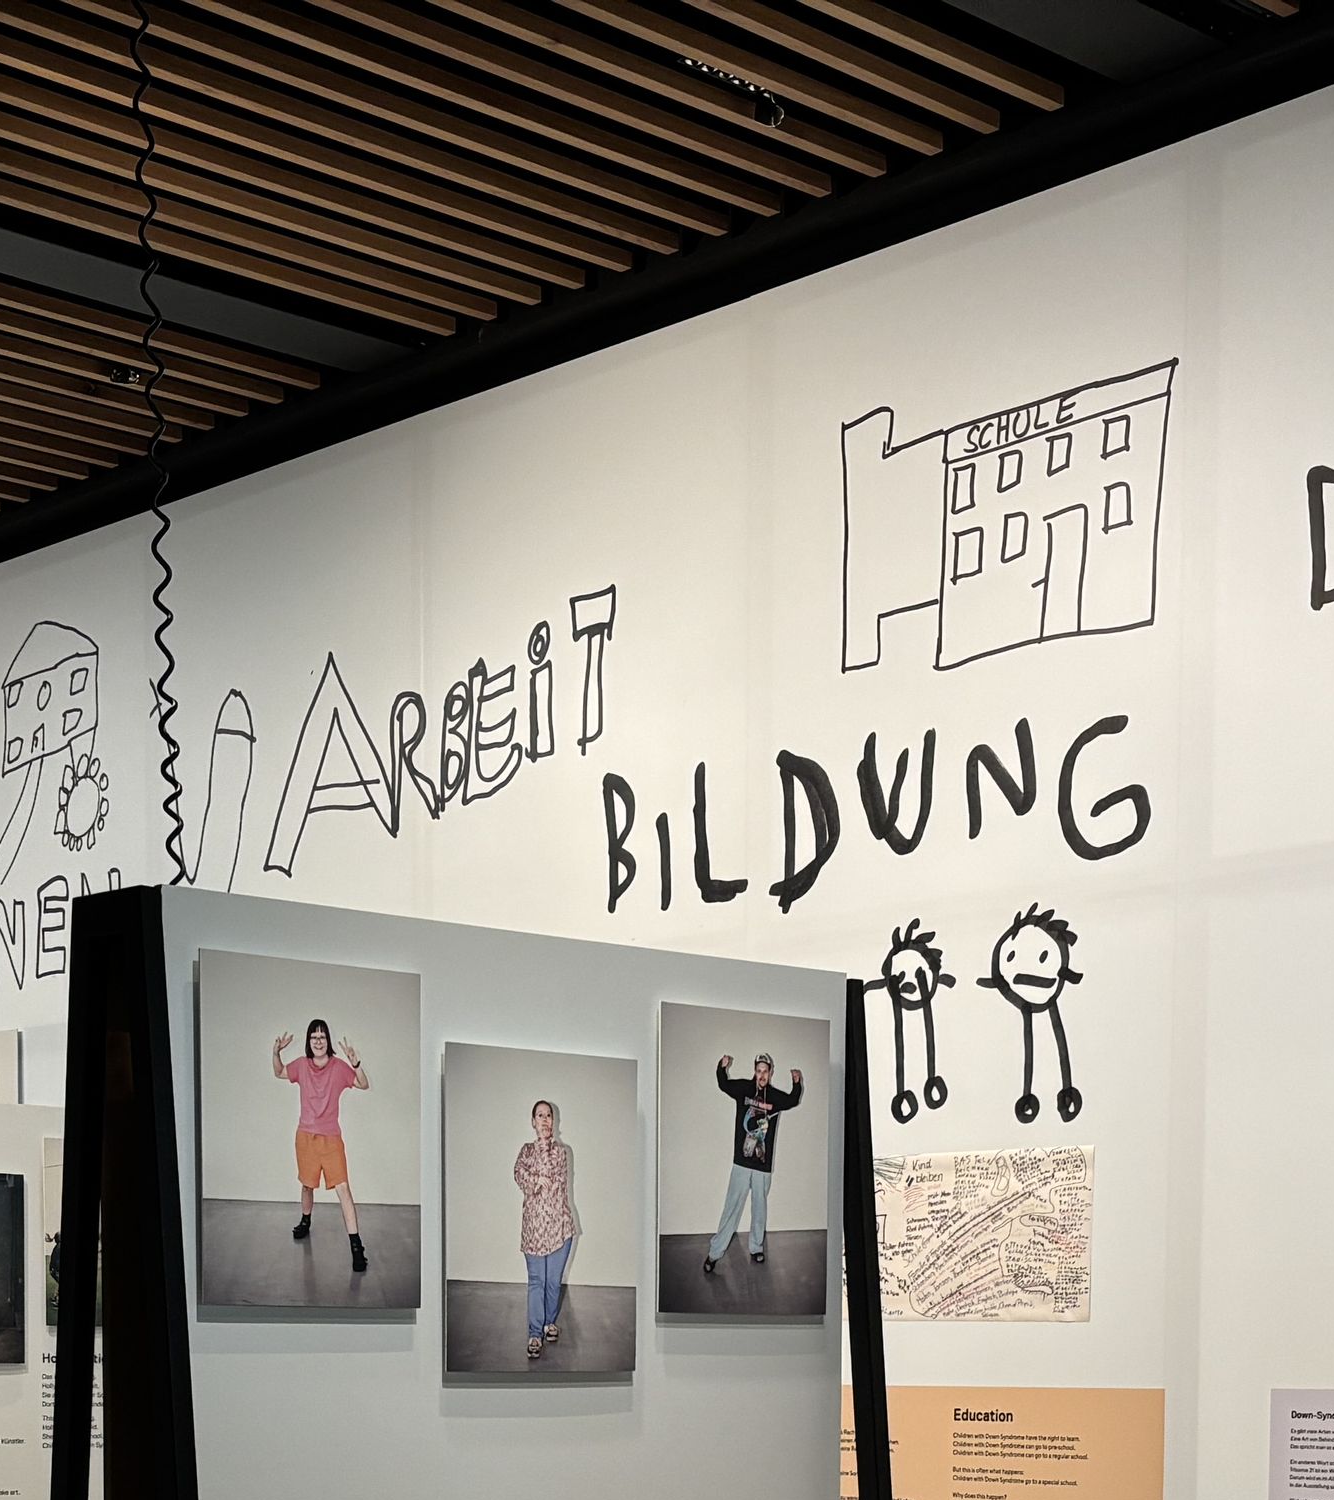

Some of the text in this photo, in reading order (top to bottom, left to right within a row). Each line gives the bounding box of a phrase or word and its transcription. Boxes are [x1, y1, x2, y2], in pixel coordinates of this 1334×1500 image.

[963, 398, 1076, 453] SCHULE
[602, 716, 1152, 913] BILDUNG
[953, 1408, 1013, 1422] Education
